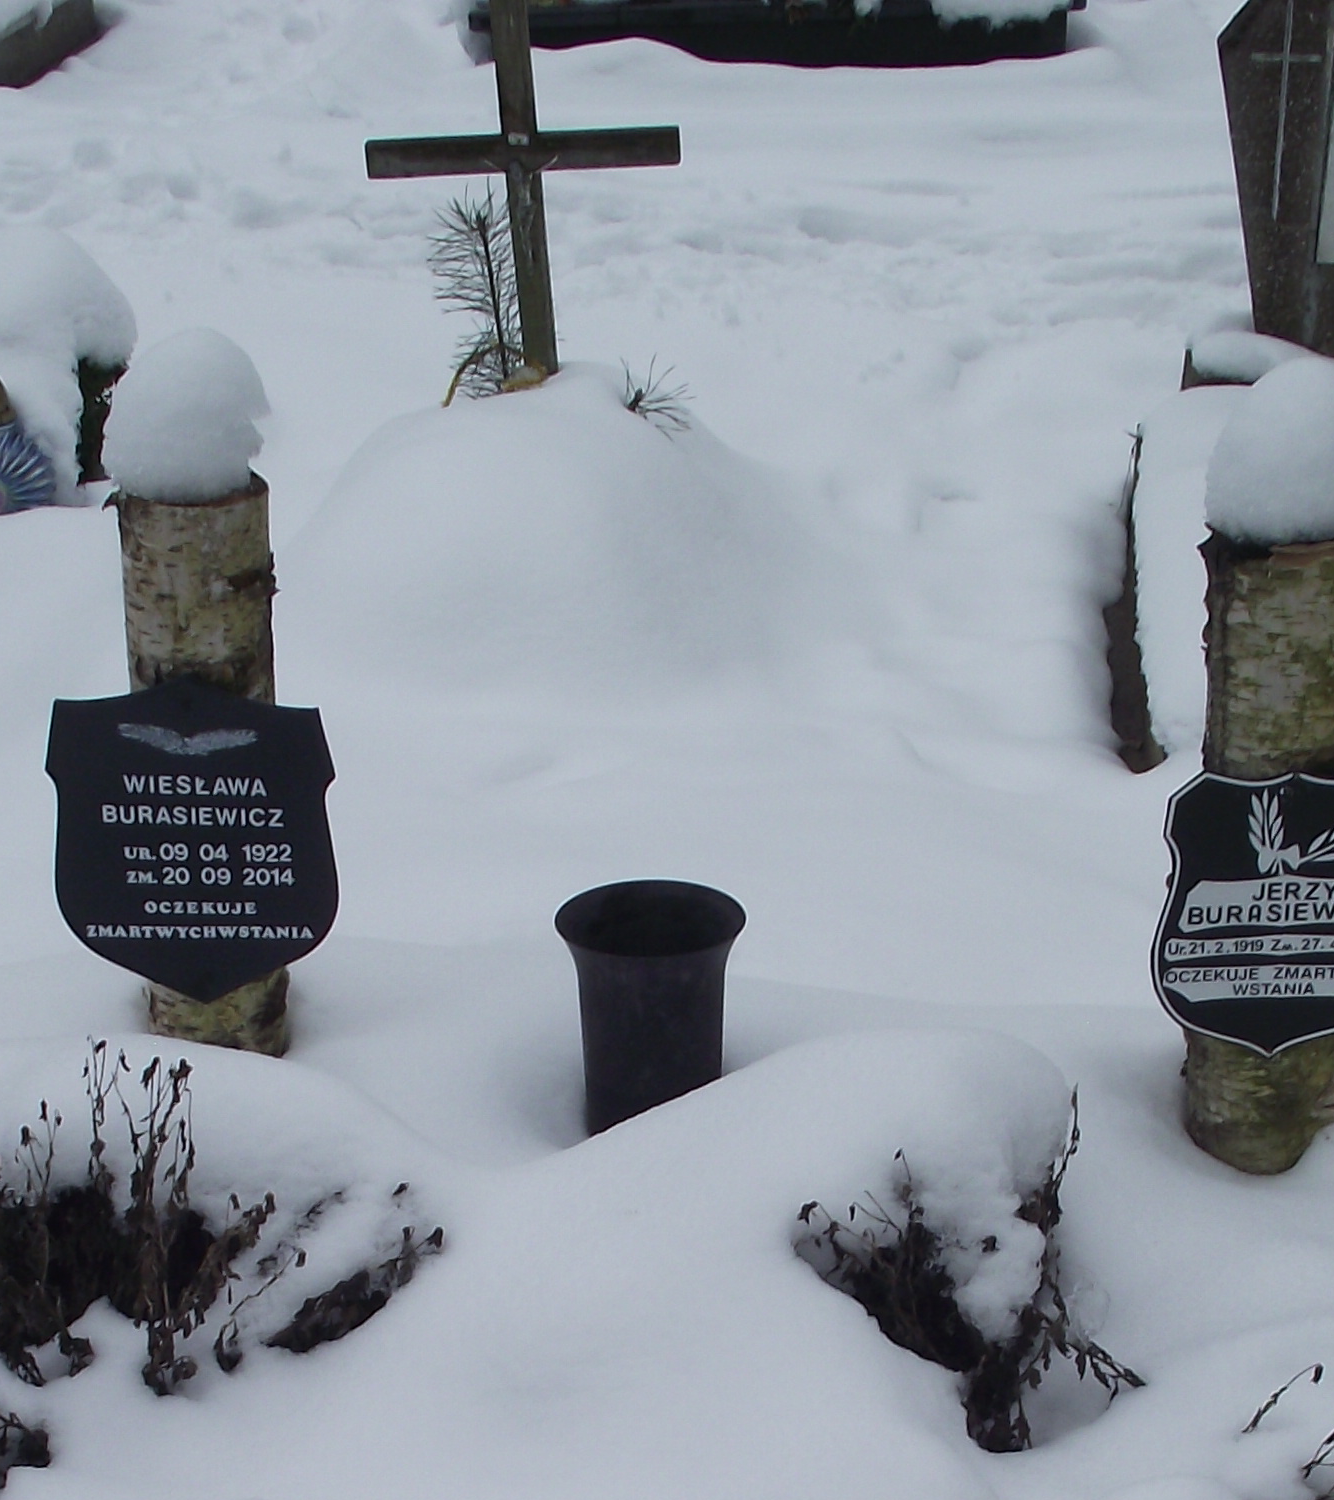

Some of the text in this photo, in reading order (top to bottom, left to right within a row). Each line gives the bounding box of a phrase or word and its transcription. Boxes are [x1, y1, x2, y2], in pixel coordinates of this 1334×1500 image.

[122, 774, 267, 798] WIESŁAWA
[101, 804, 285, 828] BURASIEWICZ
[199, 843, 229, 862] 04
[241, 843, 293, 863] 1922
[200, 867, 232, 886] 09
[242, 867, 295, 887] 2014
[143, 900, 258, 916] OCZEKUJE
[85, 924, 315, 941] ZMARTWYCHWSTANIA
[1165, 967, 1260, 984] OCZEKUJE
[1232, 982, 1315, 996] WSTANIA
